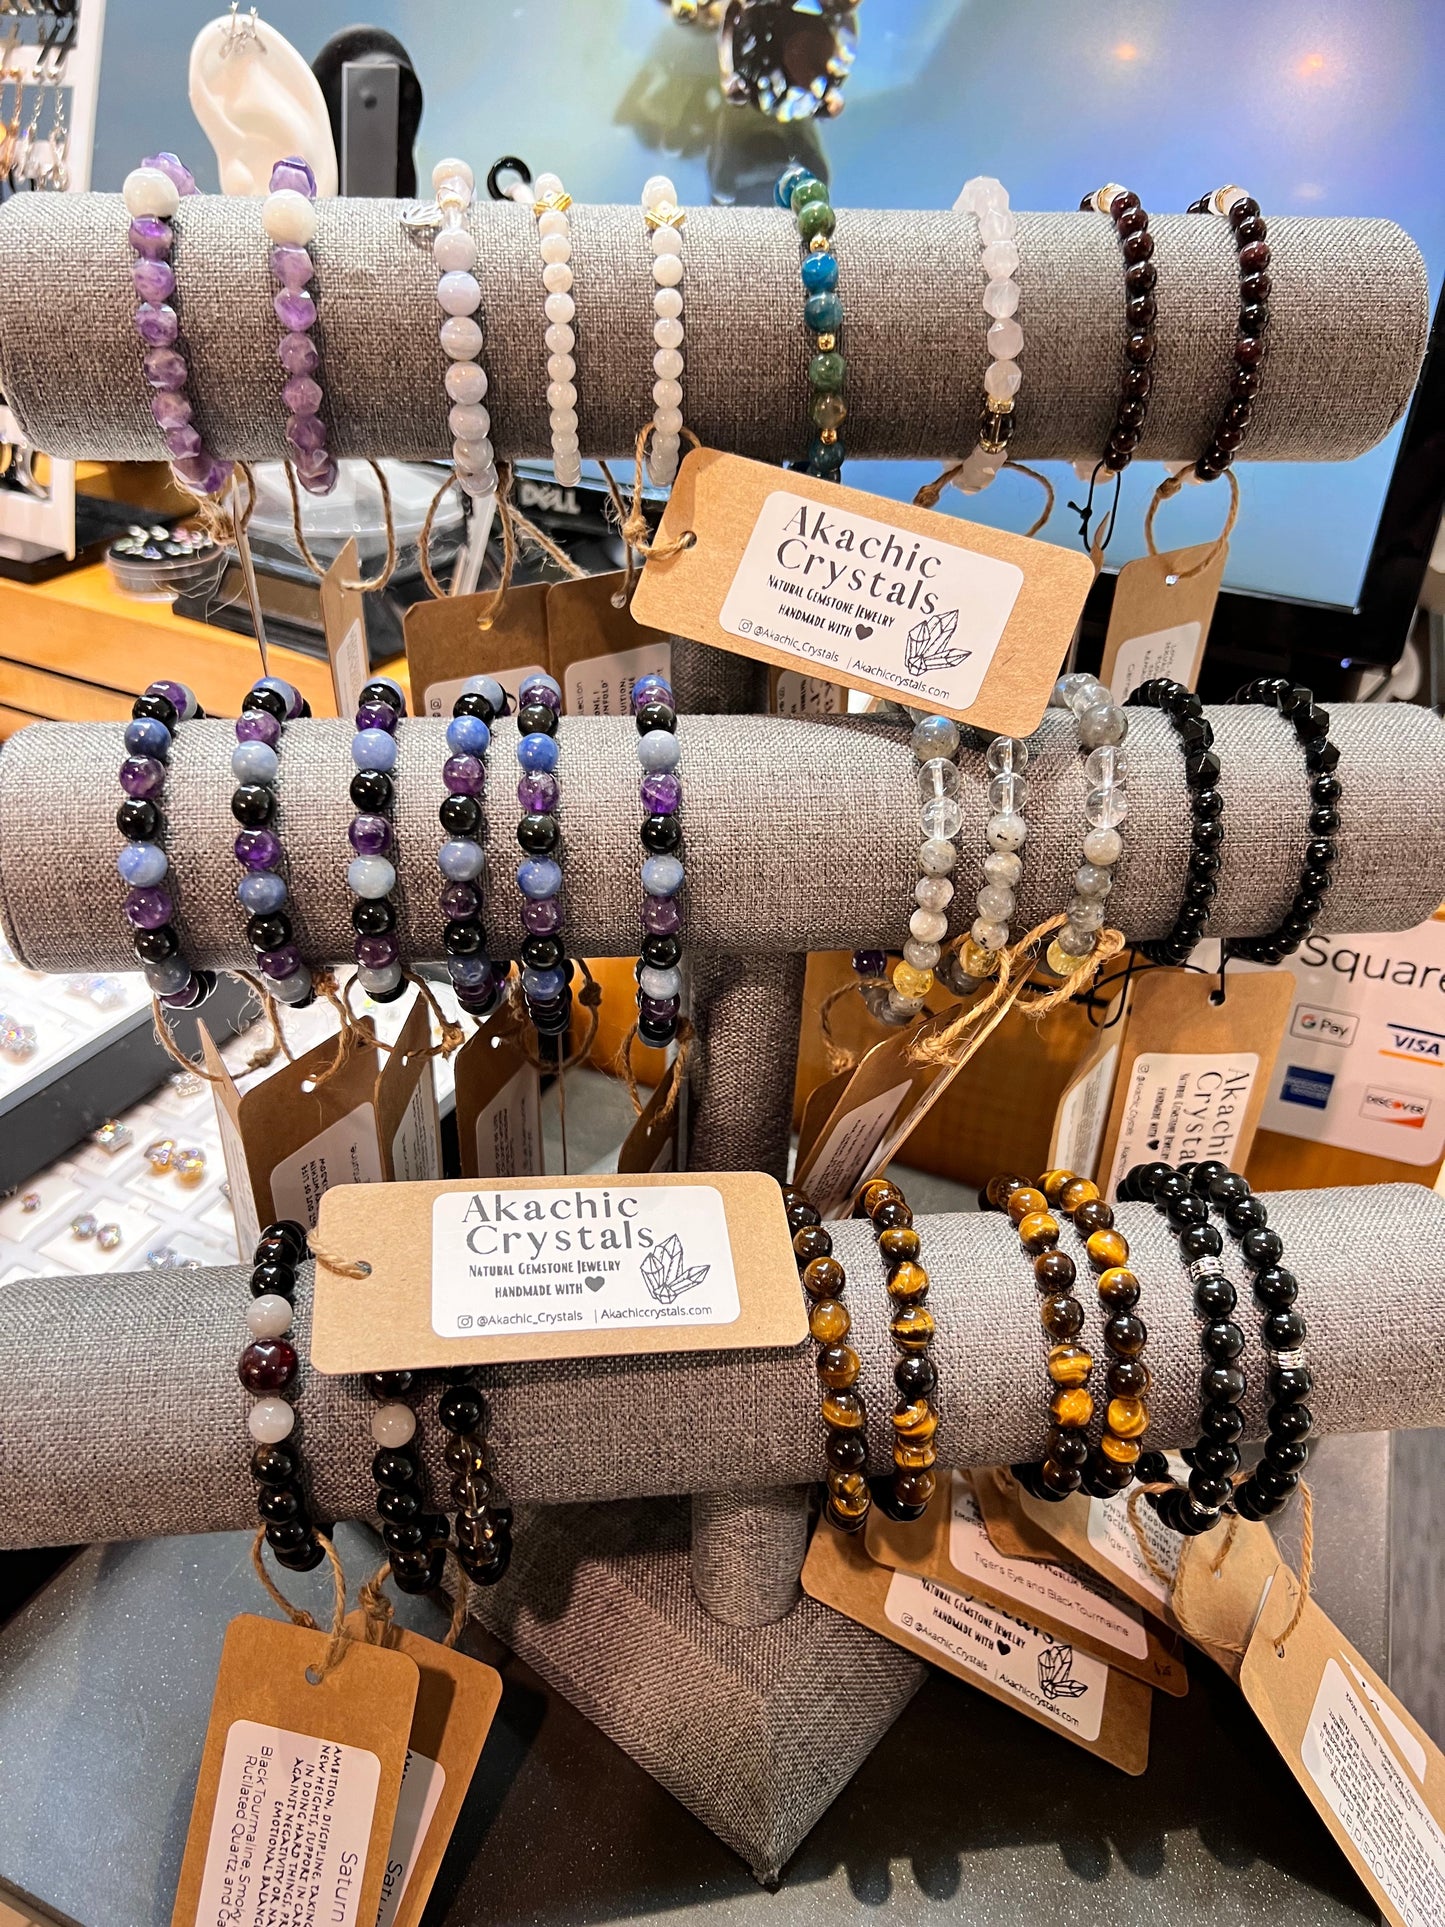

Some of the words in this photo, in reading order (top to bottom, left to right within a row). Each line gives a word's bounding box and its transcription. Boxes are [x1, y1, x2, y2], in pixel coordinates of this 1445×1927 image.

[521, 483, 581, 514] DELL
[781, 505, 942, 579] Akachic
[776, 537, 939, 616] Crystals
[1320, 1017, 1350, 1039] Pay
[1394, 1034, 1441, 1057] VISA
[1178, 1071, 1224, 1161] Crysta
[1206, 1067, 1250, 1157] Akachi
[1366, 1094, 1425, 1115] DISCOVER
[461, 1190, 639, 1222] Akachic
[466, 1220, 655, 1262] Crystals
[600, 1304, 712, 1321] Akachiccrystals.com
[255, 1745, 273, 1785] Black
[286, 1757, 304, 1810] AGAINST
[304, 1764, 315, 1777] IN
[317, 1744, 331, 1773] NEW
[323, 1745, 343, 1809] AMBITION,
[234, 1755, 258, 1819] Rutilated
[296, 1781, 312, 1819] DOING
[307, 1776, 325, 1827] HEIGHTS,
[223, 1822, 246, 1873] Quartz,
[239, 1788, 266, 1870] Tourmaline,
[262, 1801, 284, 1871] EMOTIONAL
[272, 1813, 294, 1884] NEGATIVITY
[289, 1822, 305, 1858] HARD
[311, 1814, 331, 1879] DISCIPLINE,
[1335, 1801, 1387, 1879] Obsidian
[298, 1830, 316, 1882] SUPPORT
[219, 1877, 237, 1906] and
[229, 1873, 251, 1924] Smoky
[270, 1887, 281, 1903] OR
[281, 1862, 298, 1907] THINGS,
[296, 1885, 306, 1899] IN
[330, 1850, 359, 1922] Saturn
